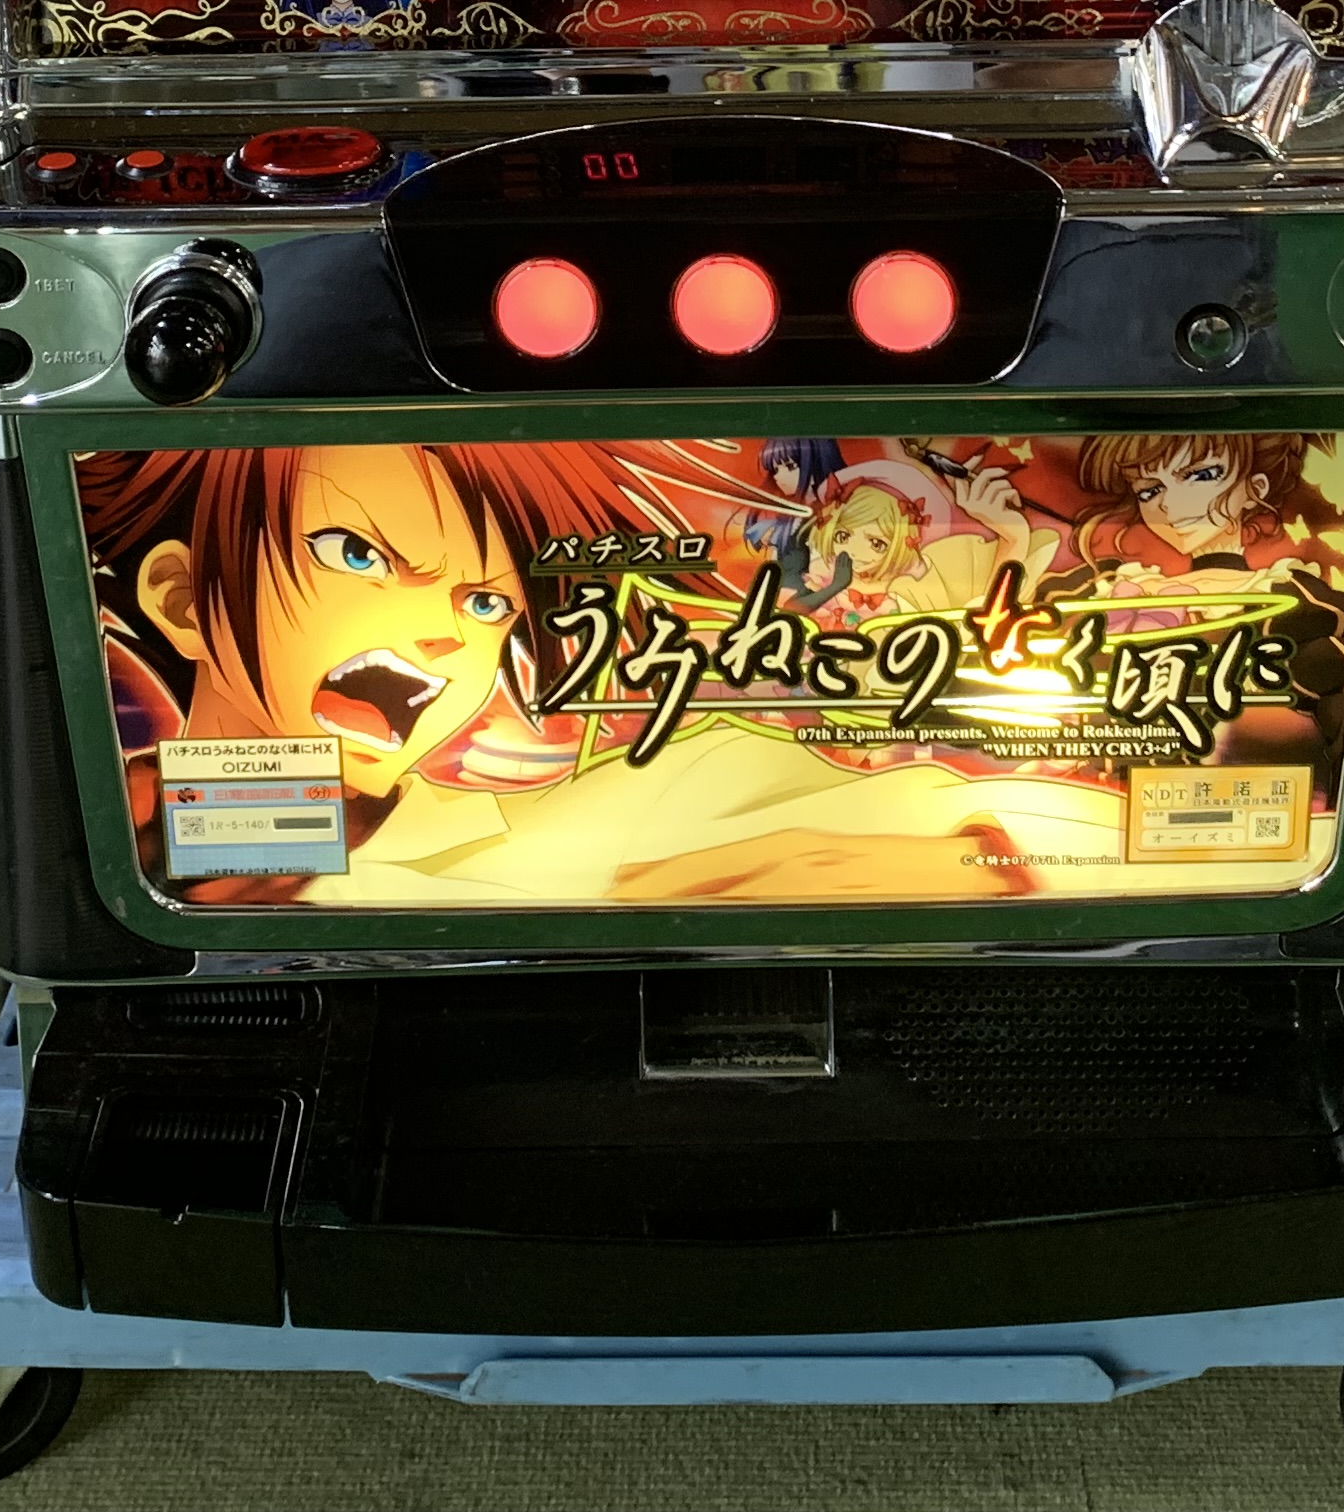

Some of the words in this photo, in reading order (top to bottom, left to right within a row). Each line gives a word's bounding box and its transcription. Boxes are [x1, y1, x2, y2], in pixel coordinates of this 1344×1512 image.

[34, 277, 76, 292] 1BET
[41, 350, 107, 364] CANCEL
[537, 534, 707, 563] パチスロ
[541, 566, 1291, 760] うみねこのなく頃に
[798, 726, 831, 742] 07th
[835, 726, 916, 744] Expansion
[991, 724, 1060, 740] Welcome
[1063, 725, 1079, 740] to
[1082, 723, 1181, 743] Rokkenjima.
[983, 742, 1049, 757] "WHEN
[1055, 742, 1103, 757] THEY
[1105, 741, 1182, 756] CRY3+4"
[222, 760, 282, 774] OIZUMI
[1151, 832, 1236, 845] オーイズミ
[1061, 854, 1121, 866] Expansion
